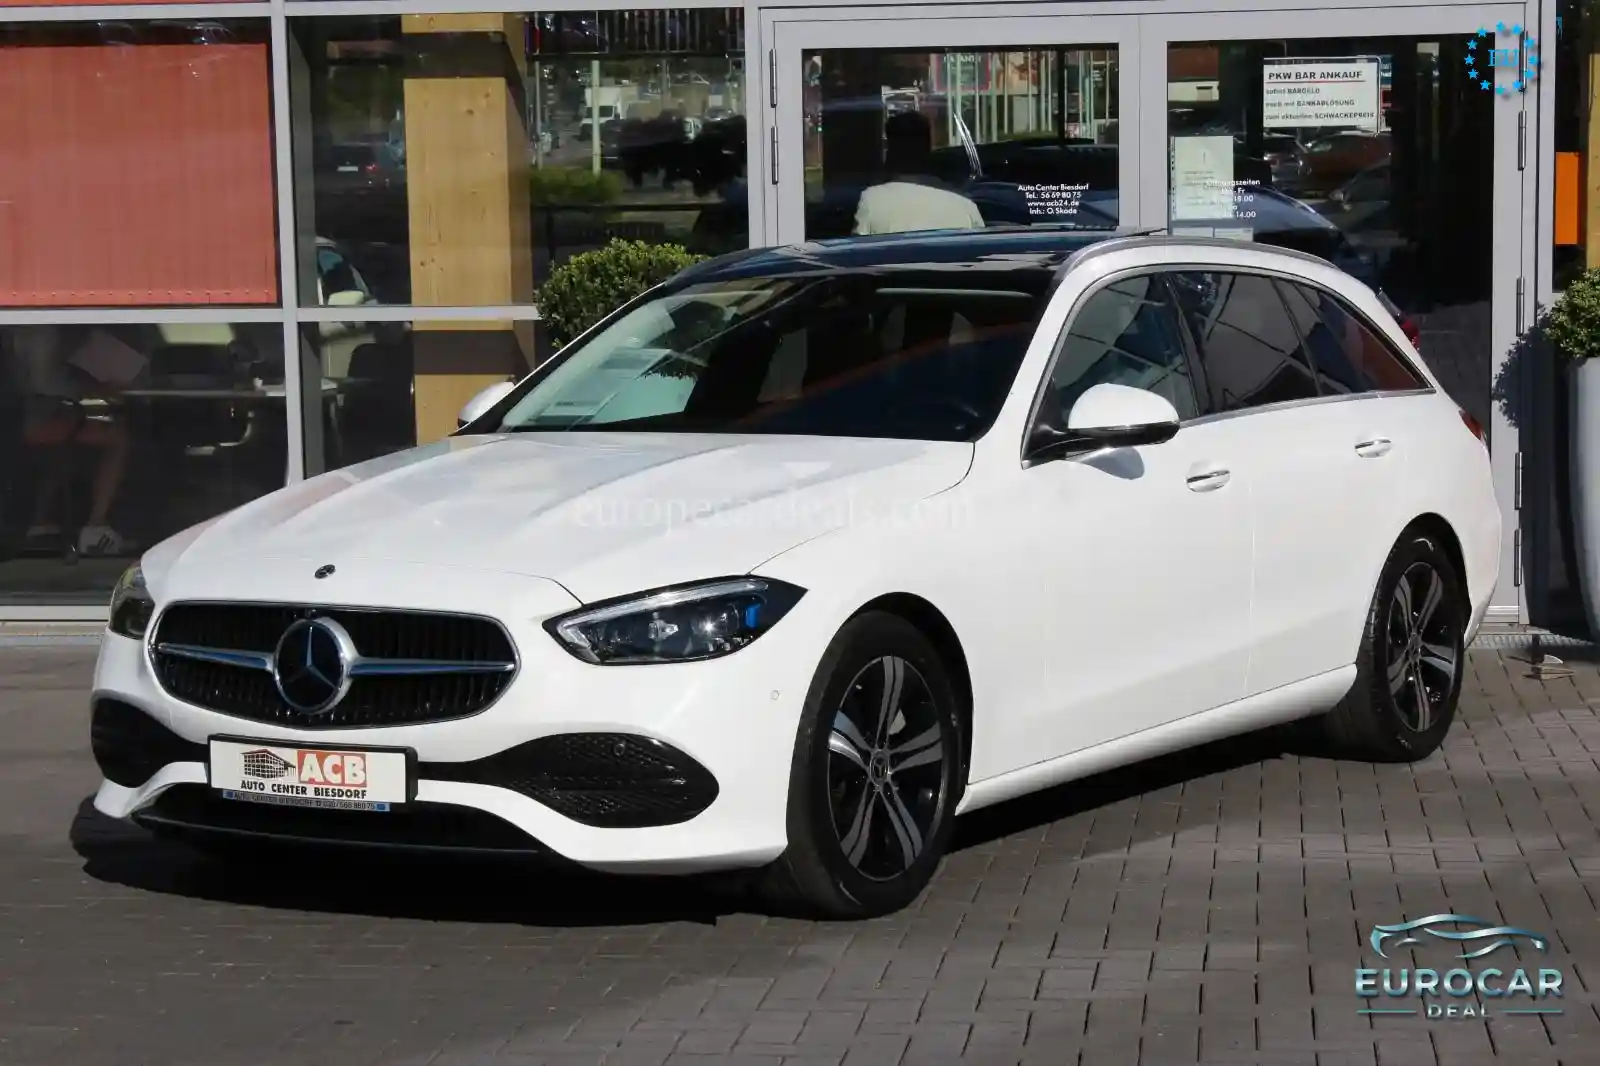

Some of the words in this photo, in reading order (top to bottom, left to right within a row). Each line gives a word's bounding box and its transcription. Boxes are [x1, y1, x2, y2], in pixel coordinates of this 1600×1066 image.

[1268, 71, 1292, 80] PKW
[1295, 71, 1316, 80] BAR
[1319, 70, 1363, 80] ANKAUF
[1035, 183, 1059, 191] Center
[1060, 182, 1089, 190] Biesdorf
[1238, 187, 1246, 195] Fr
[1027, 199, 1079, 207] www.acb24.de
[1029, 207, 1045, 215] Inh.:
[299, 753, 366, 785] ACB
[240, 780, 265, 792] AUTO
[271, 783, 307, 796] CENTER
[314, 786, 367, 800] BIESDORF
